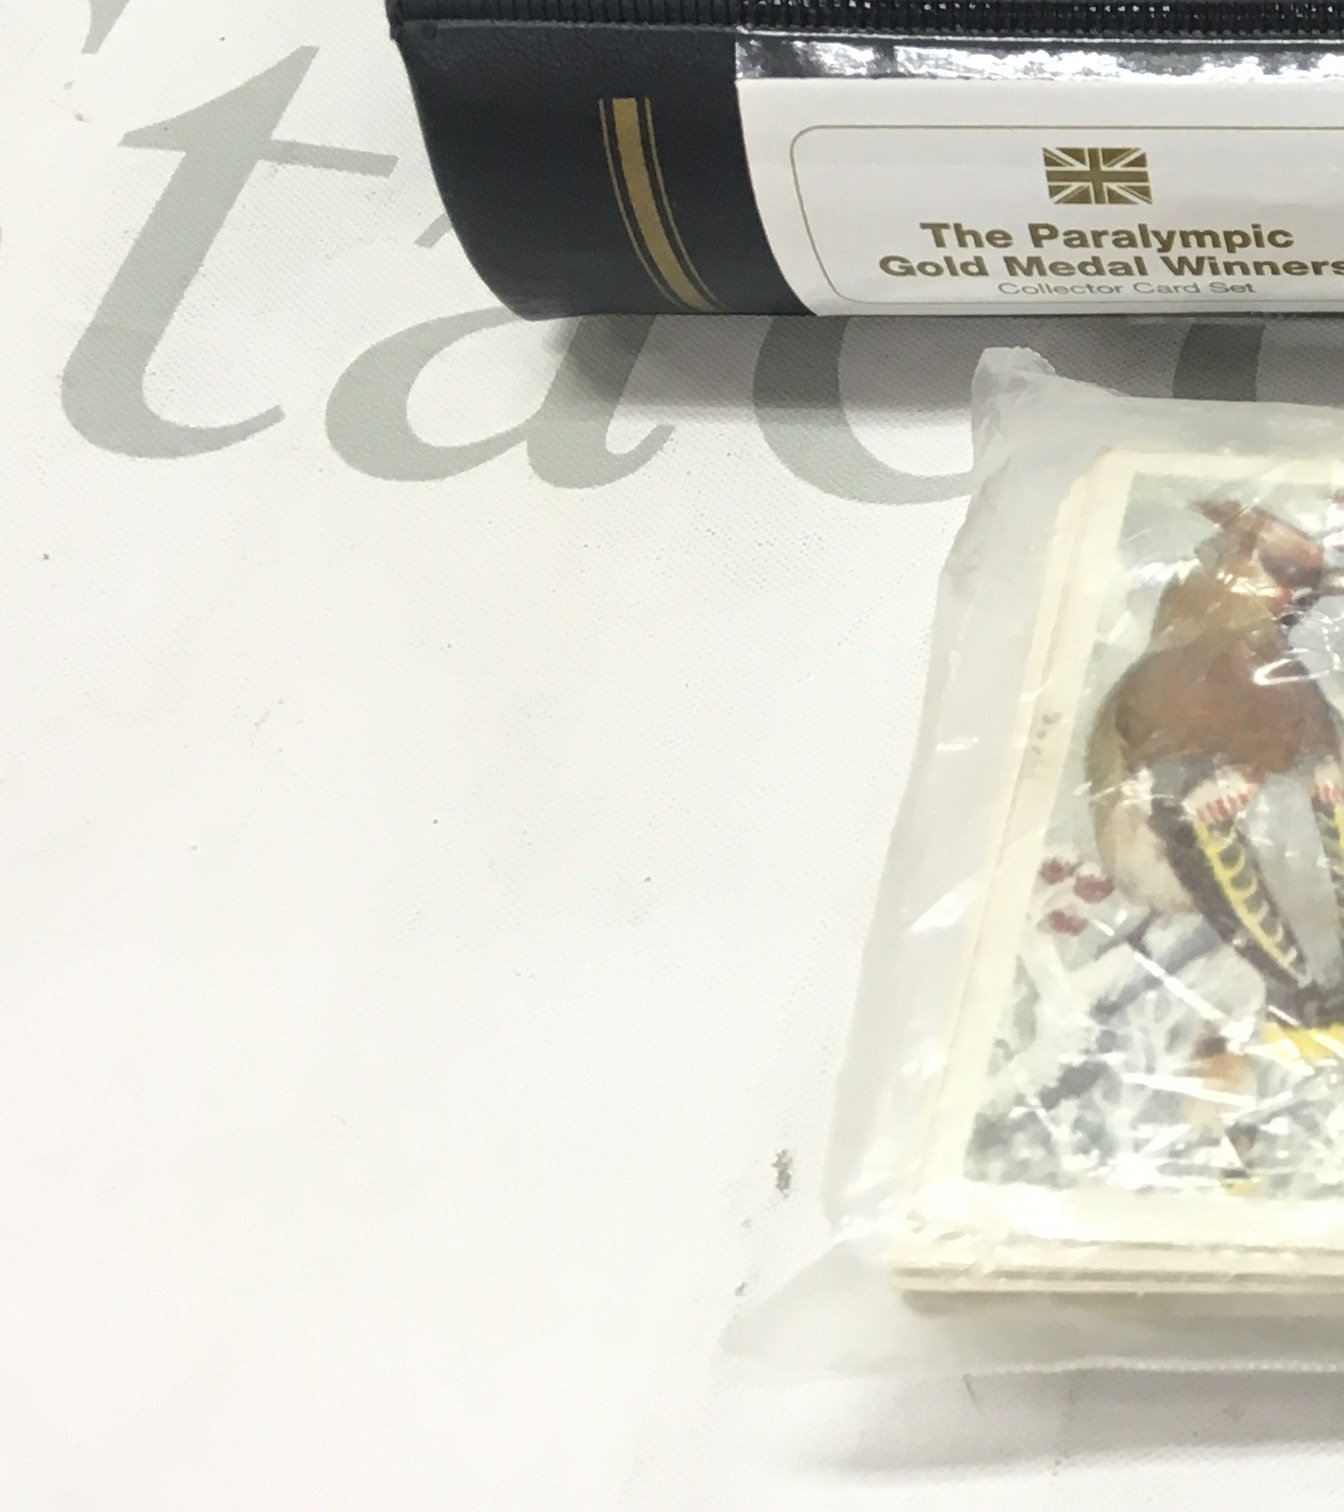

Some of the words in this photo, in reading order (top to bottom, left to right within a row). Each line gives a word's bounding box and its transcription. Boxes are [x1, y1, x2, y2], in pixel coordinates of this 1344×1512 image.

[920, 222, 1013, 249] The
[1028, 222, 1295, 254] Paralympic
[879, 255, 988, 278] Gold
[1005, 255, 1148, 278] Medal
[998, 281, 1123, 296] Collector
[1133, 281, 1201, 296] Card
[1210, 281, 1255, 296] Set
